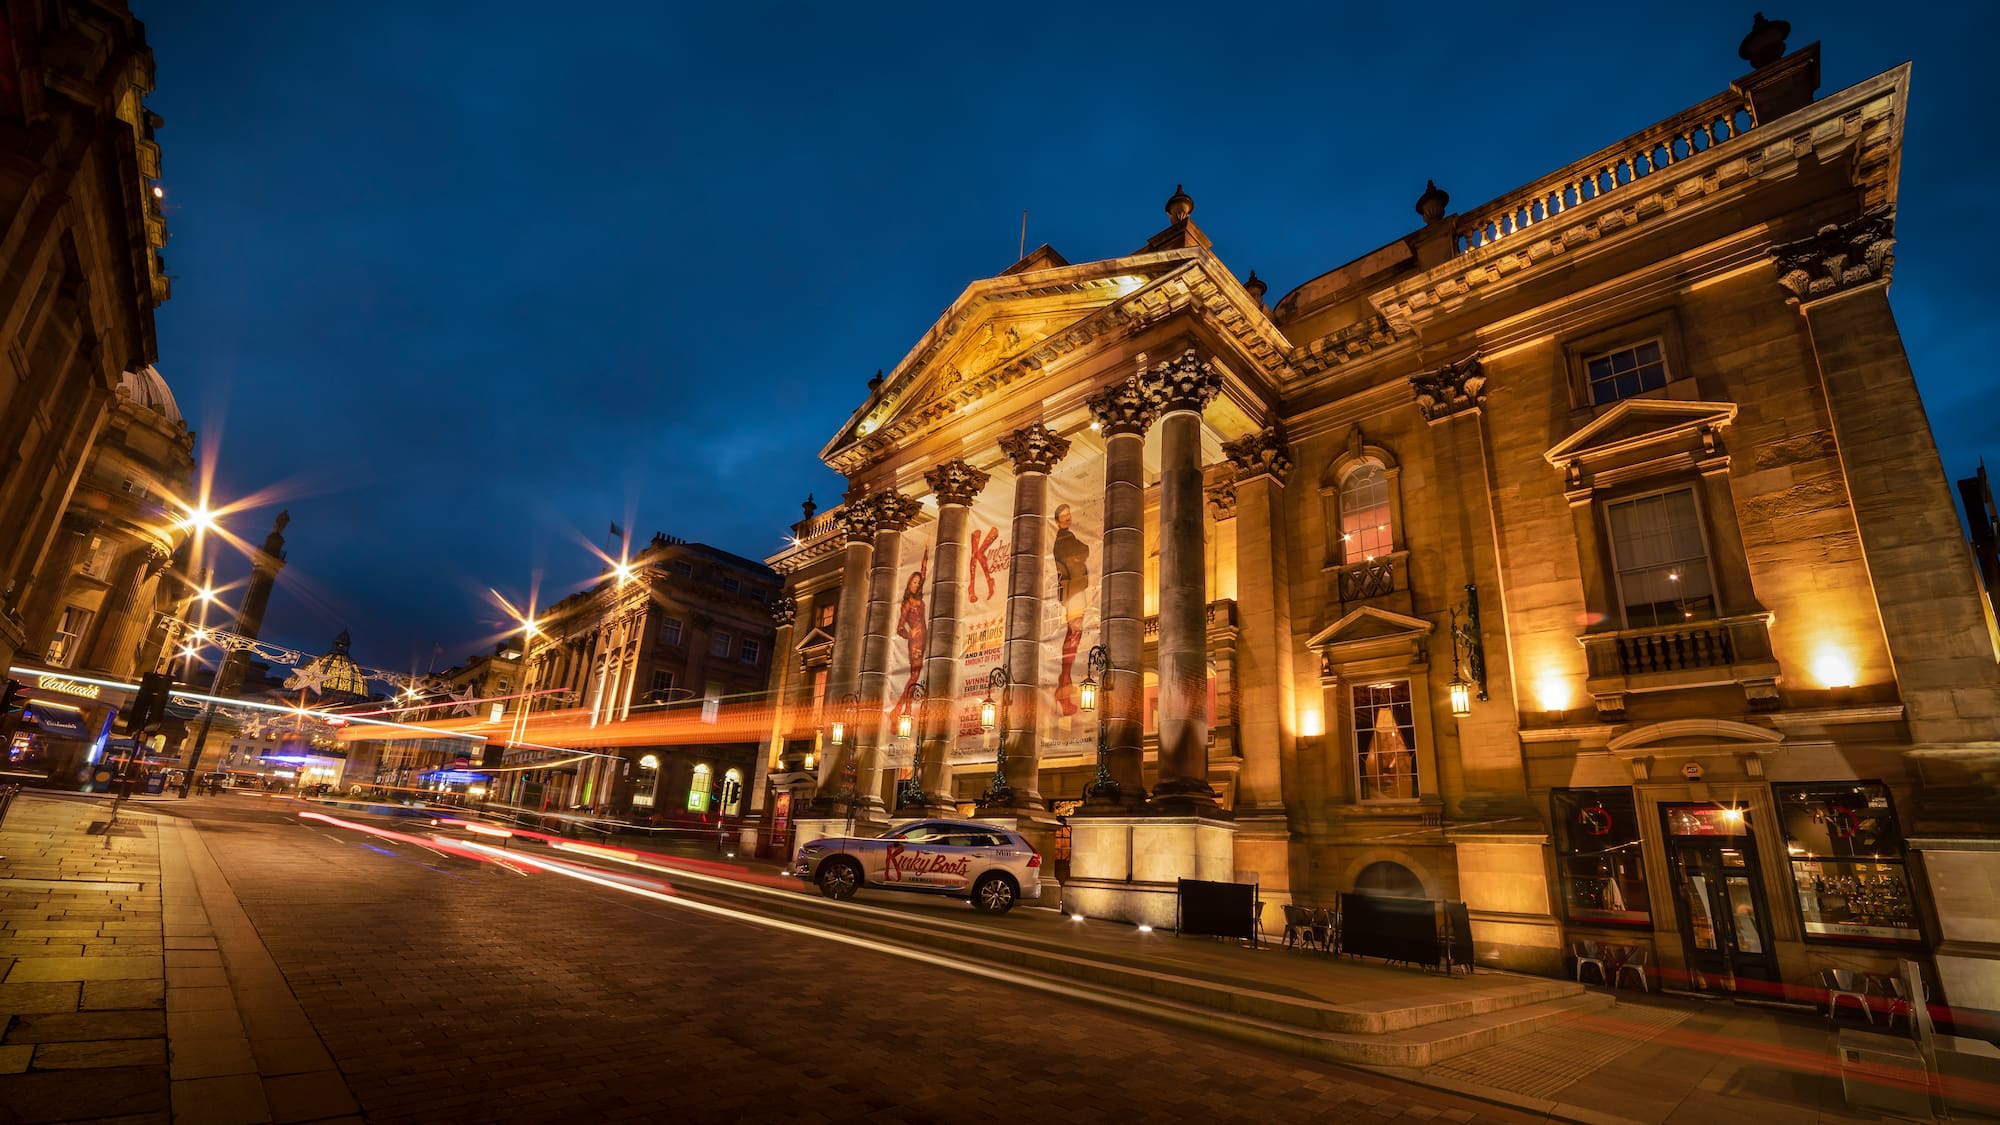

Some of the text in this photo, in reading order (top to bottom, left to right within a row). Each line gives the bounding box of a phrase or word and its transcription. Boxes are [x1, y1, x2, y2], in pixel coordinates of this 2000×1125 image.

[965, 651, 978, 659] AND
[984, 647, 1001, 655] HUGE
[38, 675, 99, 699] Carluccio's
[885, 844, 972, 882] Kinky Boots
